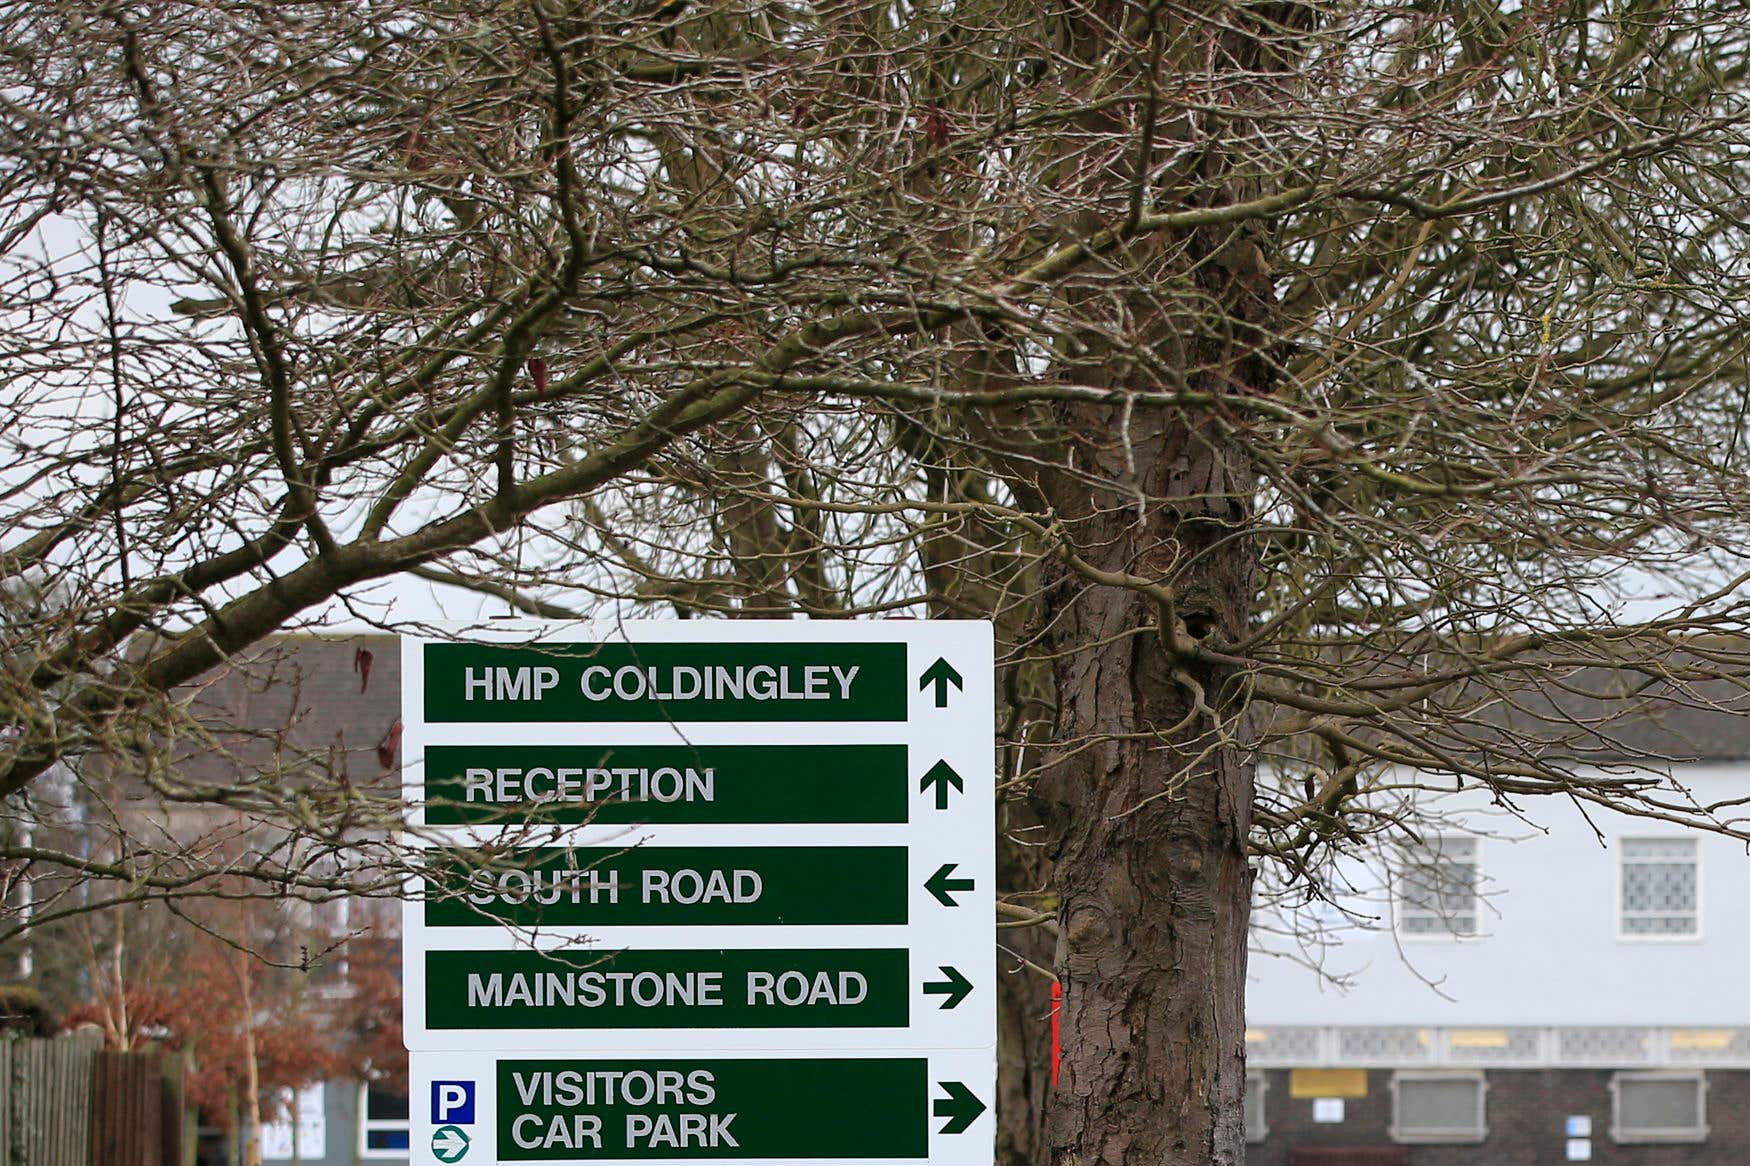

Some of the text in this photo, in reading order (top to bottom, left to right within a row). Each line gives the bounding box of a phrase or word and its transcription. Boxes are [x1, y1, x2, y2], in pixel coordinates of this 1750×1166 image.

[466, 665, 860, 701] HMP COLDINGLEY
[466, 767, 714, 802] RECEPTION
[467, 869, 763, 904] SOUTH ROAD
[468, 971, 868, 1007] MAINSTONE ROAD
[512, 1070, 715, 1106] VISITORS
[511, 1113, 739, 1149] CAR PARK
